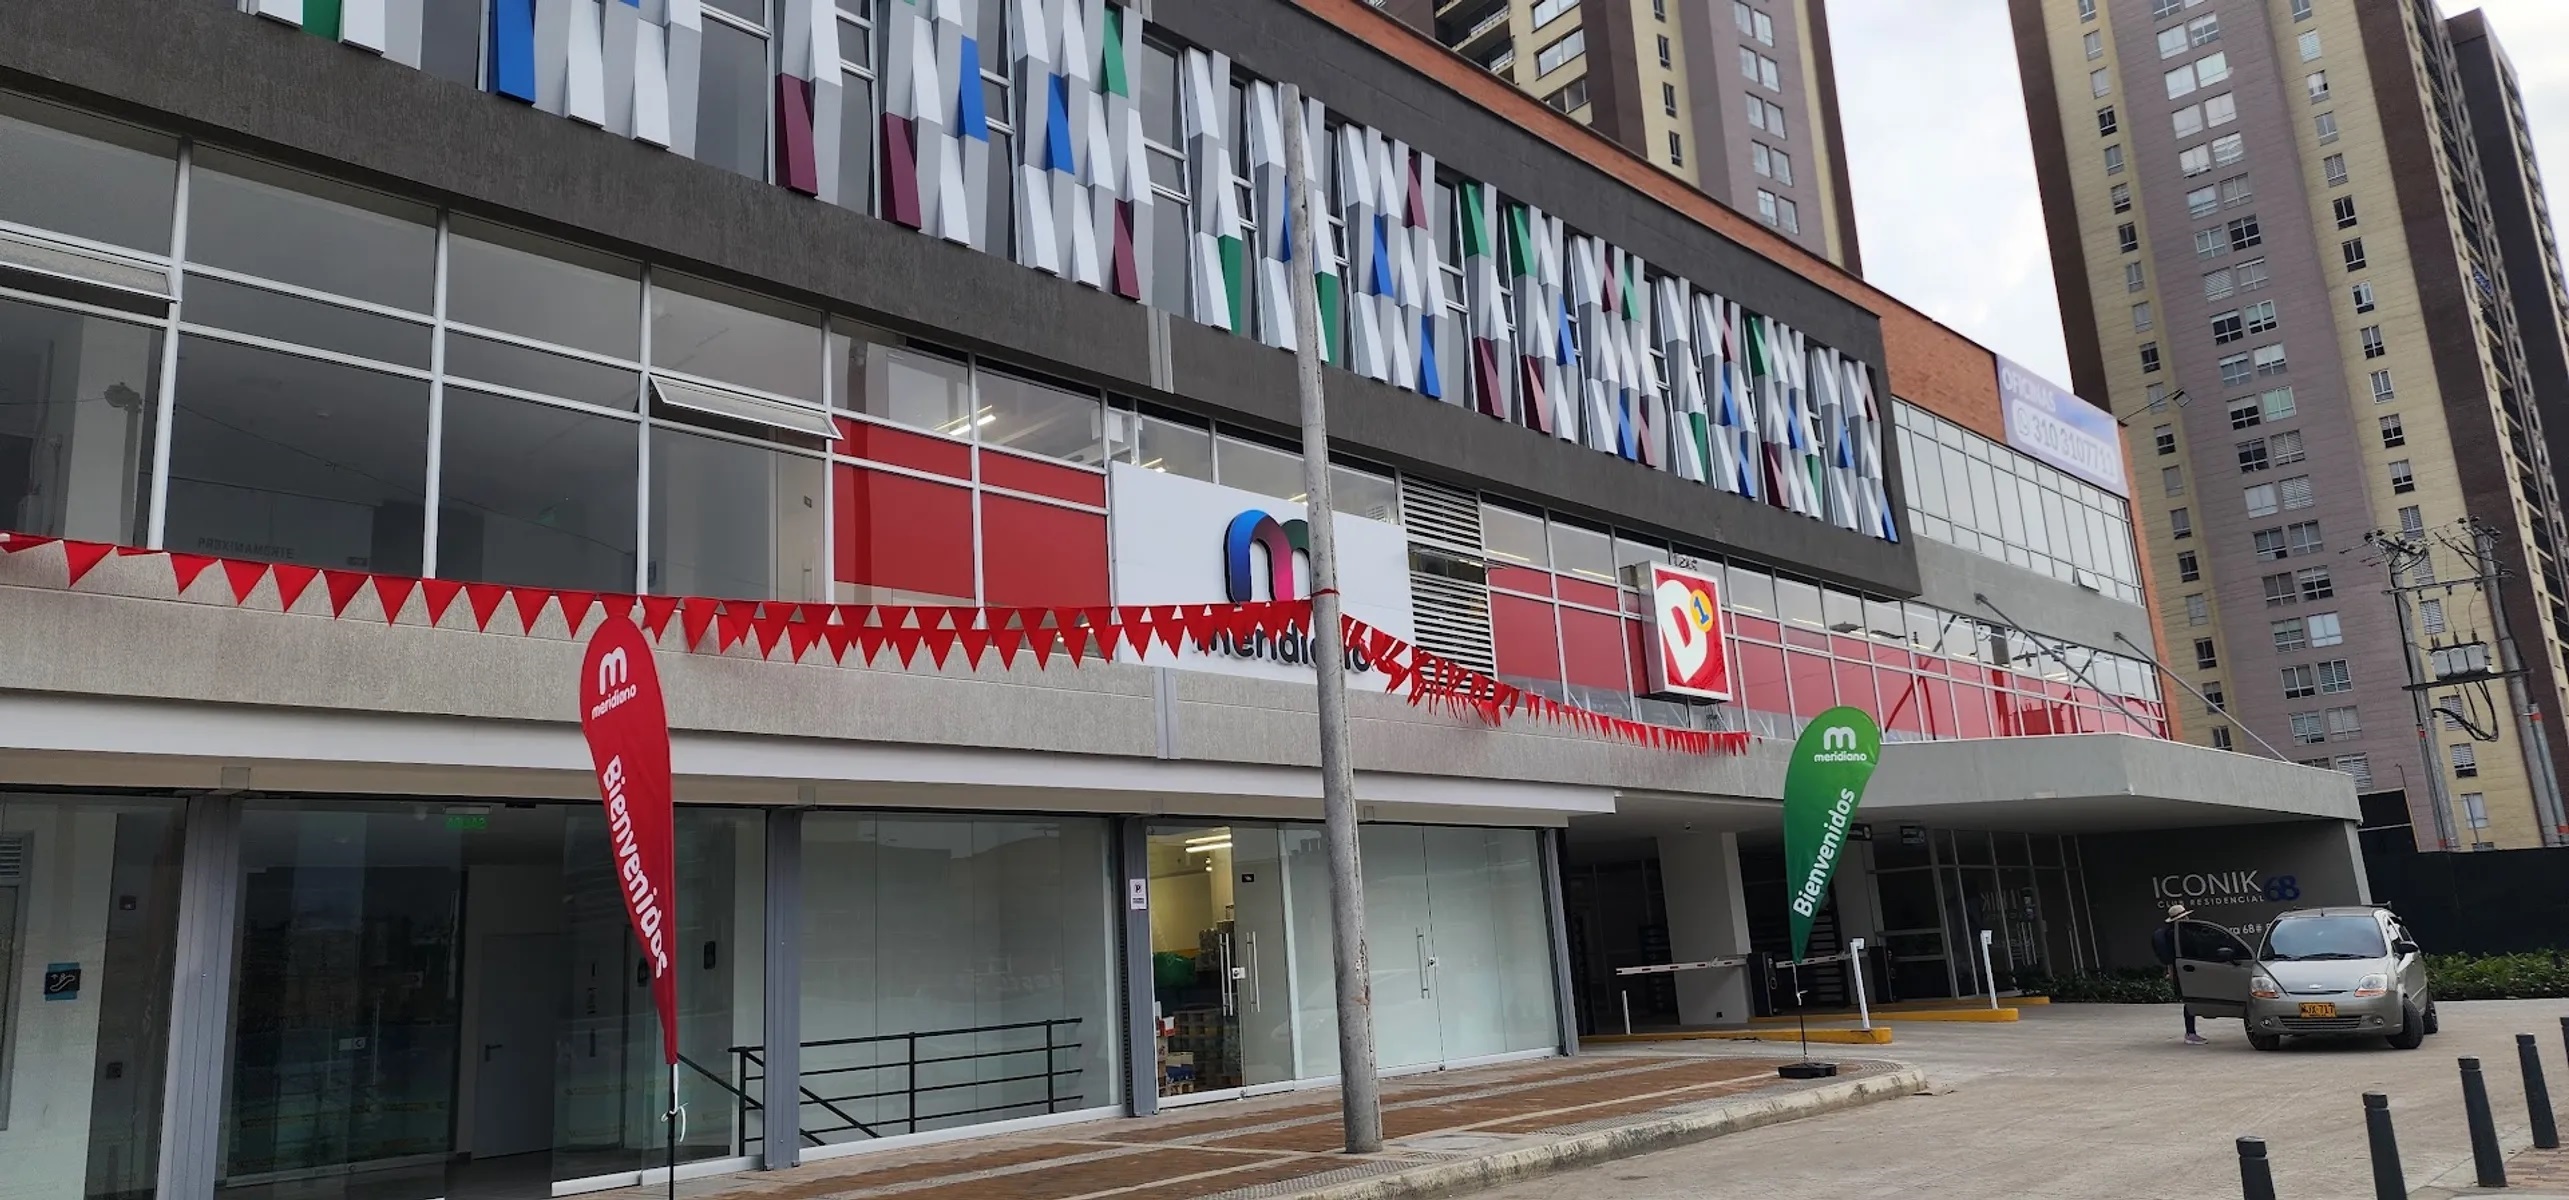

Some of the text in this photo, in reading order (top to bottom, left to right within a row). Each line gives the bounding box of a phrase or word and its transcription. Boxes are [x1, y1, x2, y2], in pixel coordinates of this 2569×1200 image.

[2032, 414, 2058, 452] 310
[591, 684, 637, 720] meridiano
[1813, 751, 1868, 763] meridiano
[602, 754, 668, 979] Bienvenidos
[1792, 787, 1856, 918] Bienvenidos
[2152, 870, 2301, 901] ICONIK 68
[2189, 896, 2265, 907] RESIDENCIAL
